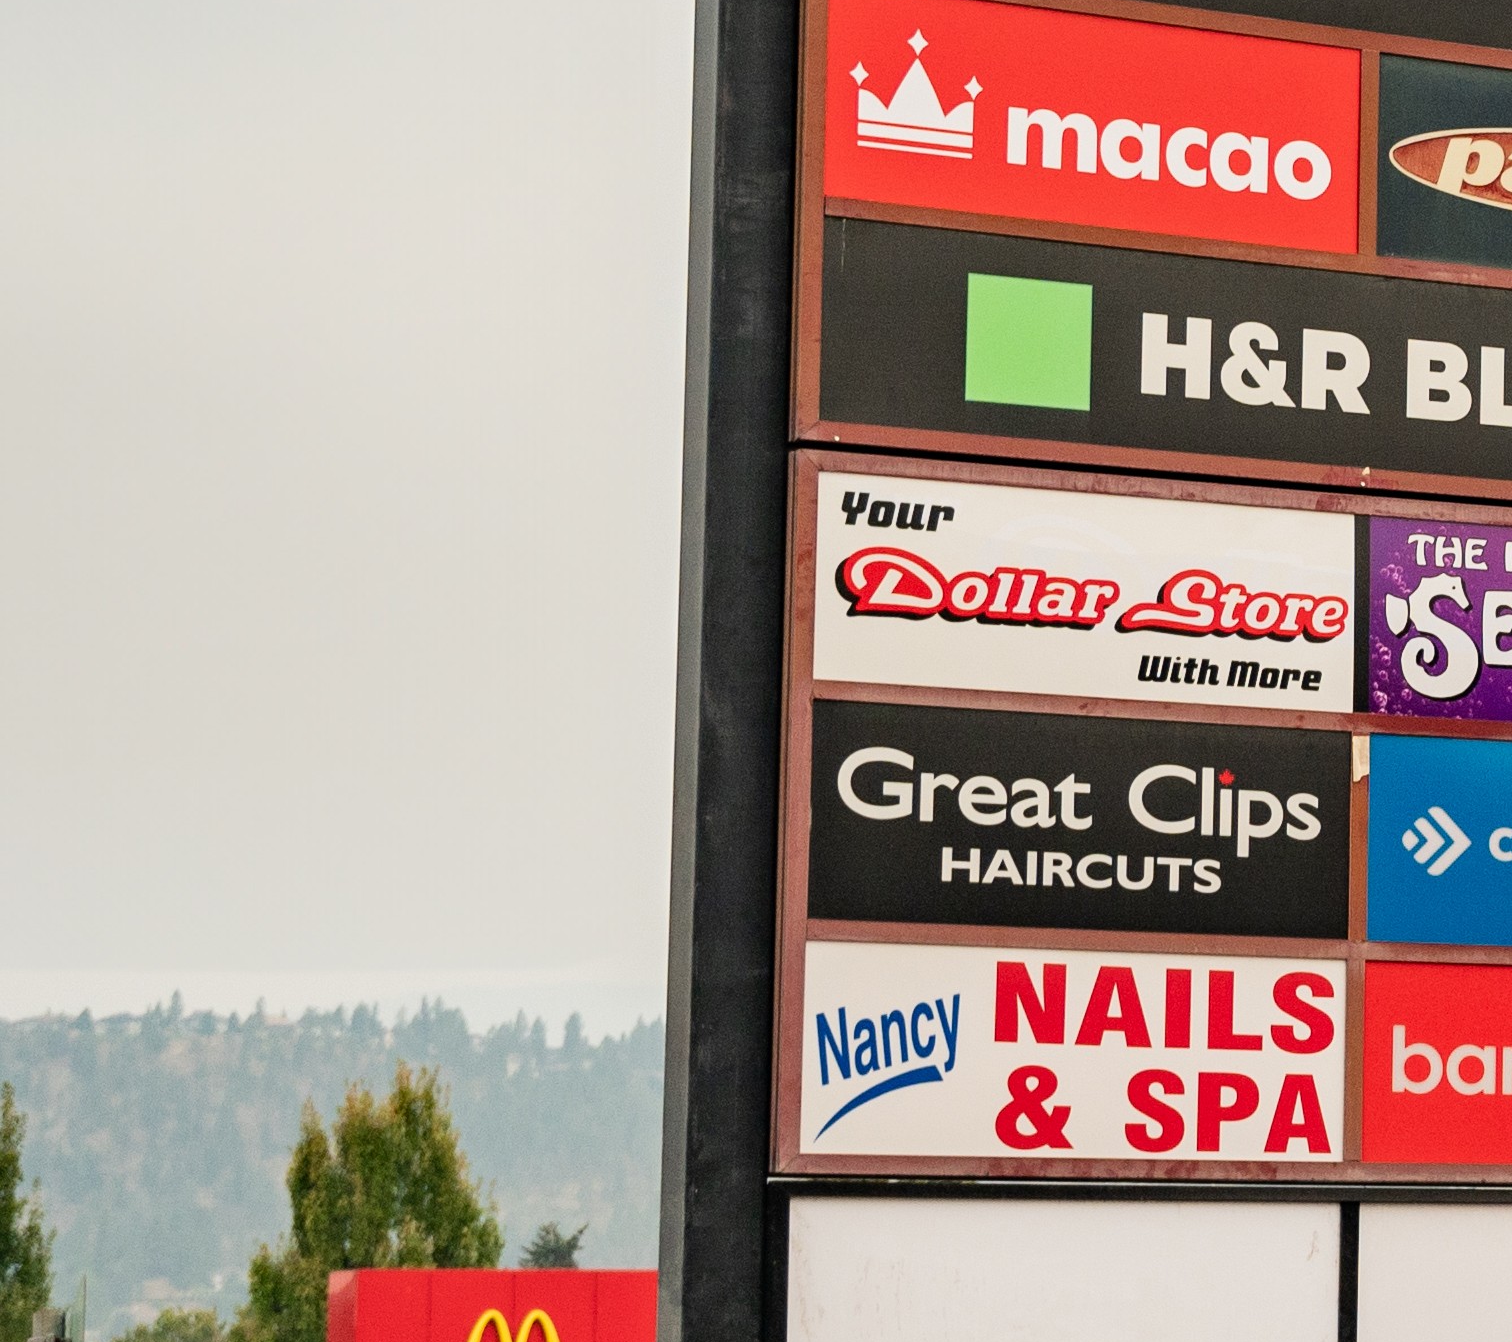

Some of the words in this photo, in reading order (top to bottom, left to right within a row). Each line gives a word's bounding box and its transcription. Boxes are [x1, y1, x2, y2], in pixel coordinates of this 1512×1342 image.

[1006, 105, 1332, 200] macao
[1140, 312, 1371, 417] H&R
[840, 490, 956, 534] Your
[1407, 533, 1489, 574] THE
[837, 545, 1117, 626] Dollar
[1115, 569, 1350, 643] Store
[1137, 655, 1219, 690] With
[1224, 659, 1323, 692] More
[836, 746, 1093, 832] Great
[1129, 764, 1323, 858] Clips
[941, 847, 1222, 894] HAIRCUTS
[816, 992, 961, 1088] Nancy
[994, 960, 1336, 1052] NAILS
[994, 1065, 1074, 1150] &
[1124, 1070, 1331, 1154] SPA
